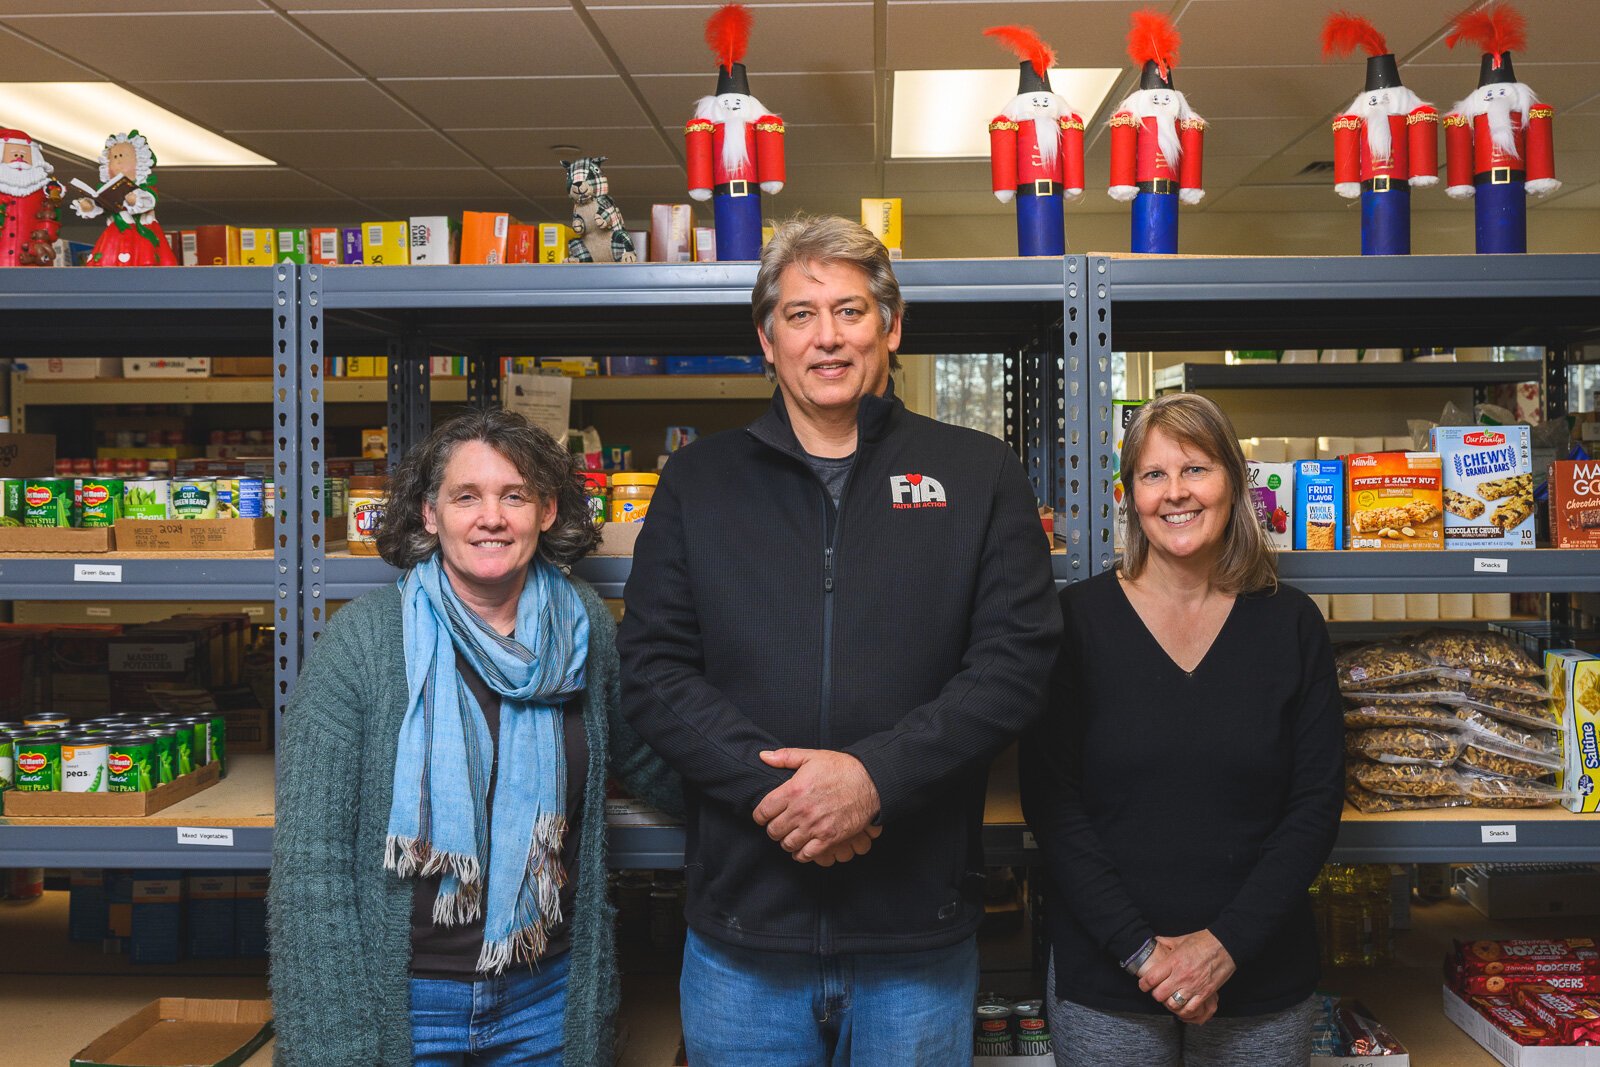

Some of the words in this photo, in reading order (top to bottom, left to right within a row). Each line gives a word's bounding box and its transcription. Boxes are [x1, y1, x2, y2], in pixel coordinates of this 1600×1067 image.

[418, 224, 426, 247] CORN
[1465, 435, 1478, 444] Our
[1479, 435, 1504, 445] Family
[1463, 448, 1508, 468] CHEWY
[1352, 459, 1378, 467] Millville
[1465, 465, 1494, 477] GRANOLA
[1494, 462, 1510, 473] BARS
[1354, 477, 1383, 486] SWEET
[1418, 477, 1436, 485] NUT
[1308, 485, 1334, 494] FRUIT
[1573, 479, 1600, 496] GO
[33, 491, 50, 499] Monte
[1308, 494, 1333, 502] FLAVOR
[175, 498, 189, 506] GREEN
[189, 498, 207, 506] BEANS
[1310, 513, 1333, 521] GRAINS
[159, 523, 183, 534] 2024
[1432, 530, 1439, 538] 6
[1521, 529, 1532, 539] 10
[1562, 536, 1568, 544] 5
[127, 653, 168, 661] MASHED
[122, 661, 172, 670] POTATOES
[1583, 724, 1599, 768] Saltine
[66, 770, 88, 778] peas
[1503, 944, 1568, 956] DODGERS
[1536, 963, 1582, 972] DODGERS
[1540, 978, 1584, 988] DGERS
[976, 1040, 1013, 1056] ONIONS
